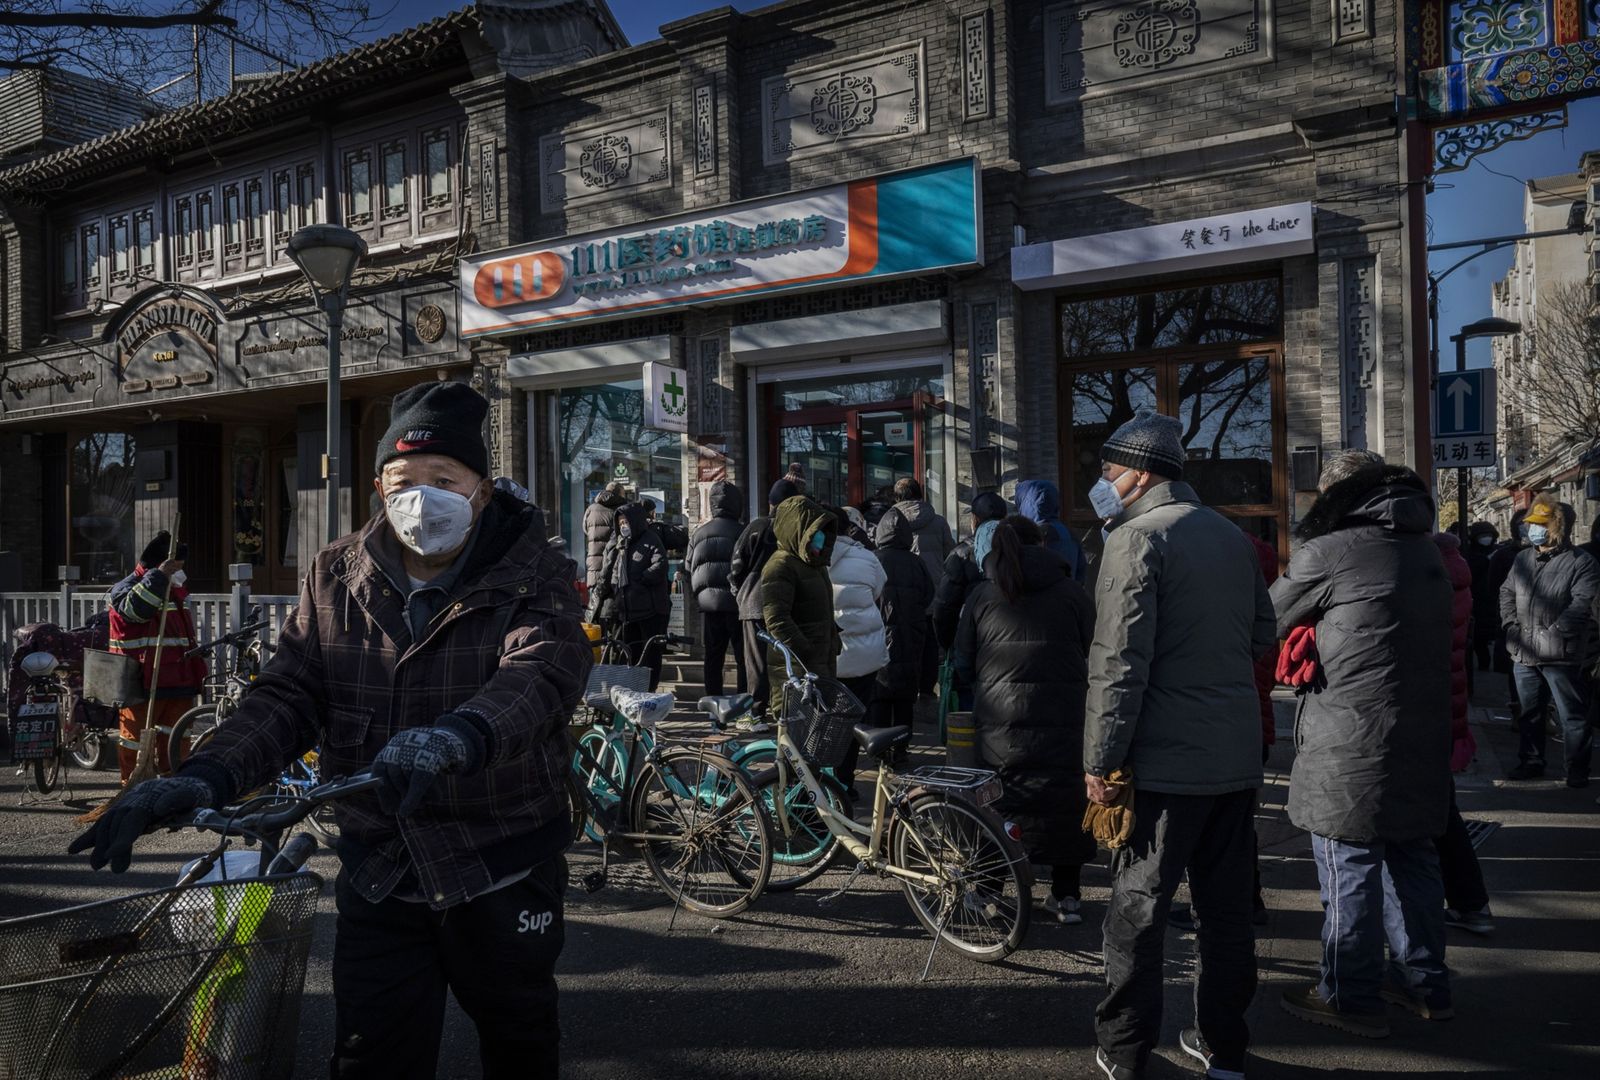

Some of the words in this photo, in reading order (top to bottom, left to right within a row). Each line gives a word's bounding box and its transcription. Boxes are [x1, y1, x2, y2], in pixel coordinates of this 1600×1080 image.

[1242, 220, 1262, 238] the
[1268, 217, 1300, 231] diner
[142, 304, 216, 343] NOSTALGIA
[404, 430, 432, 441] NIKE
[517, 909, 553, 935] Sup
